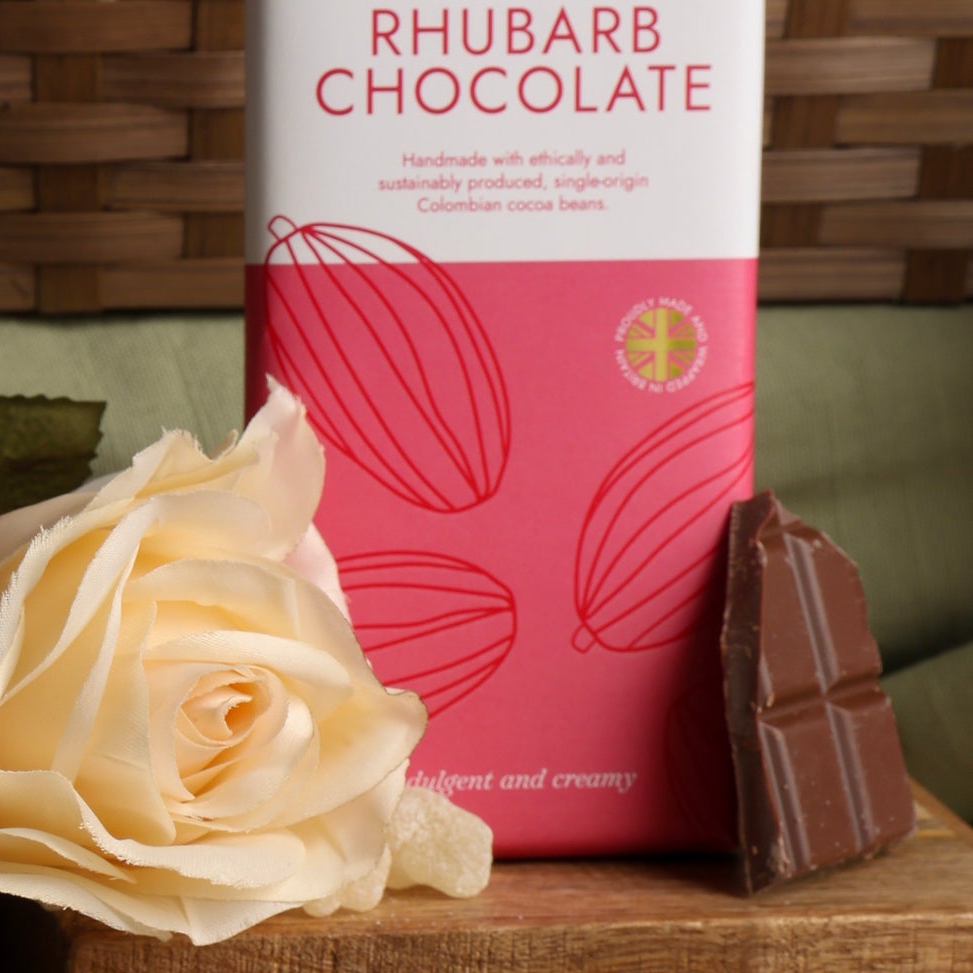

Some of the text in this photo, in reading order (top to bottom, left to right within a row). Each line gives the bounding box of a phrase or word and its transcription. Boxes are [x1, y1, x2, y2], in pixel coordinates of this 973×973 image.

[371, 7, 661, 56] RHUBARB
[315, 65, 713, 116] CHOCOLATE
[402, 149, 626, 169] Handmade with ethically and
[378, 172, 649, 193] sustainably produced, single-origin
[417, 195, 608, 213] Colombian cocoa beans.
[406, 768, 638, 796] dulgent and creamy
